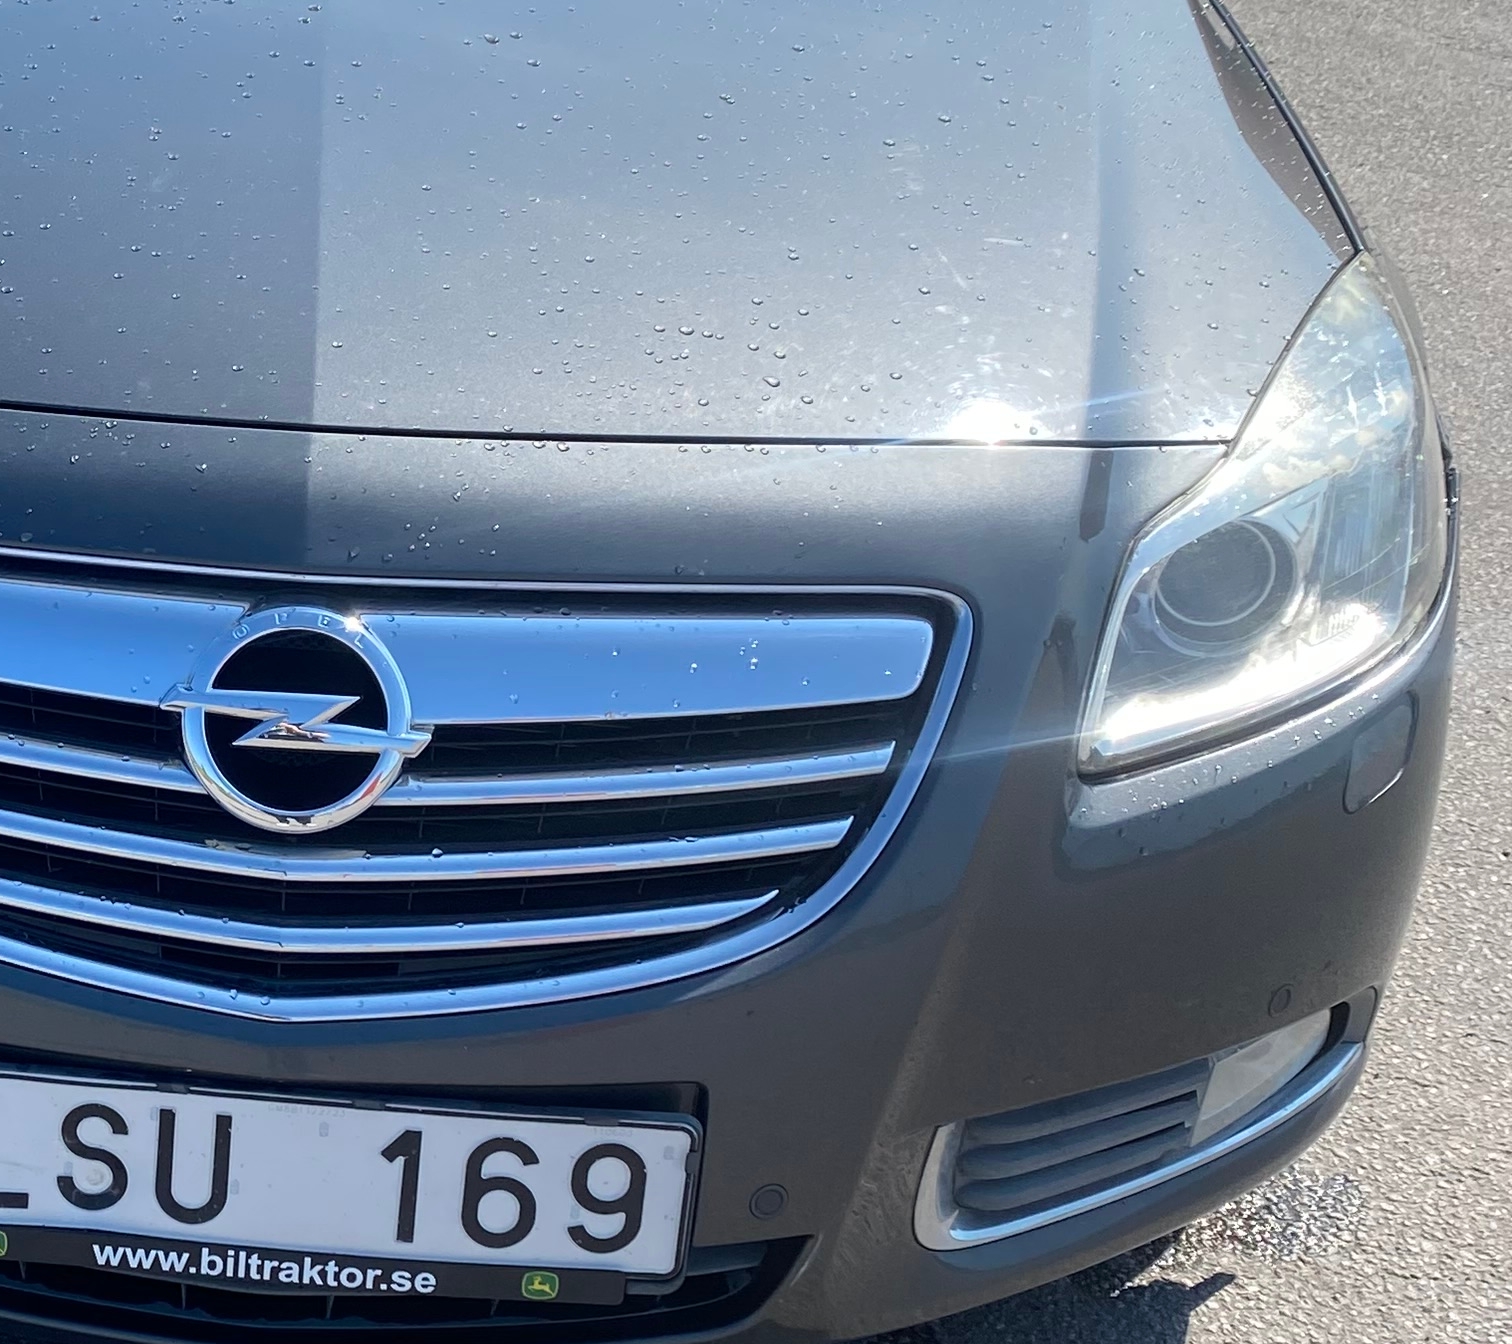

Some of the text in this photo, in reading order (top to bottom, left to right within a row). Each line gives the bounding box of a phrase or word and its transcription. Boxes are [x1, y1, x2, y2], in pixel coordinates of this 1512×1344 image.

[232, 612, 365, 649] OPEL
[381, 1129, 647, 1254] 169
[91, 1243, 437, 1294] www.biltraktor.se
